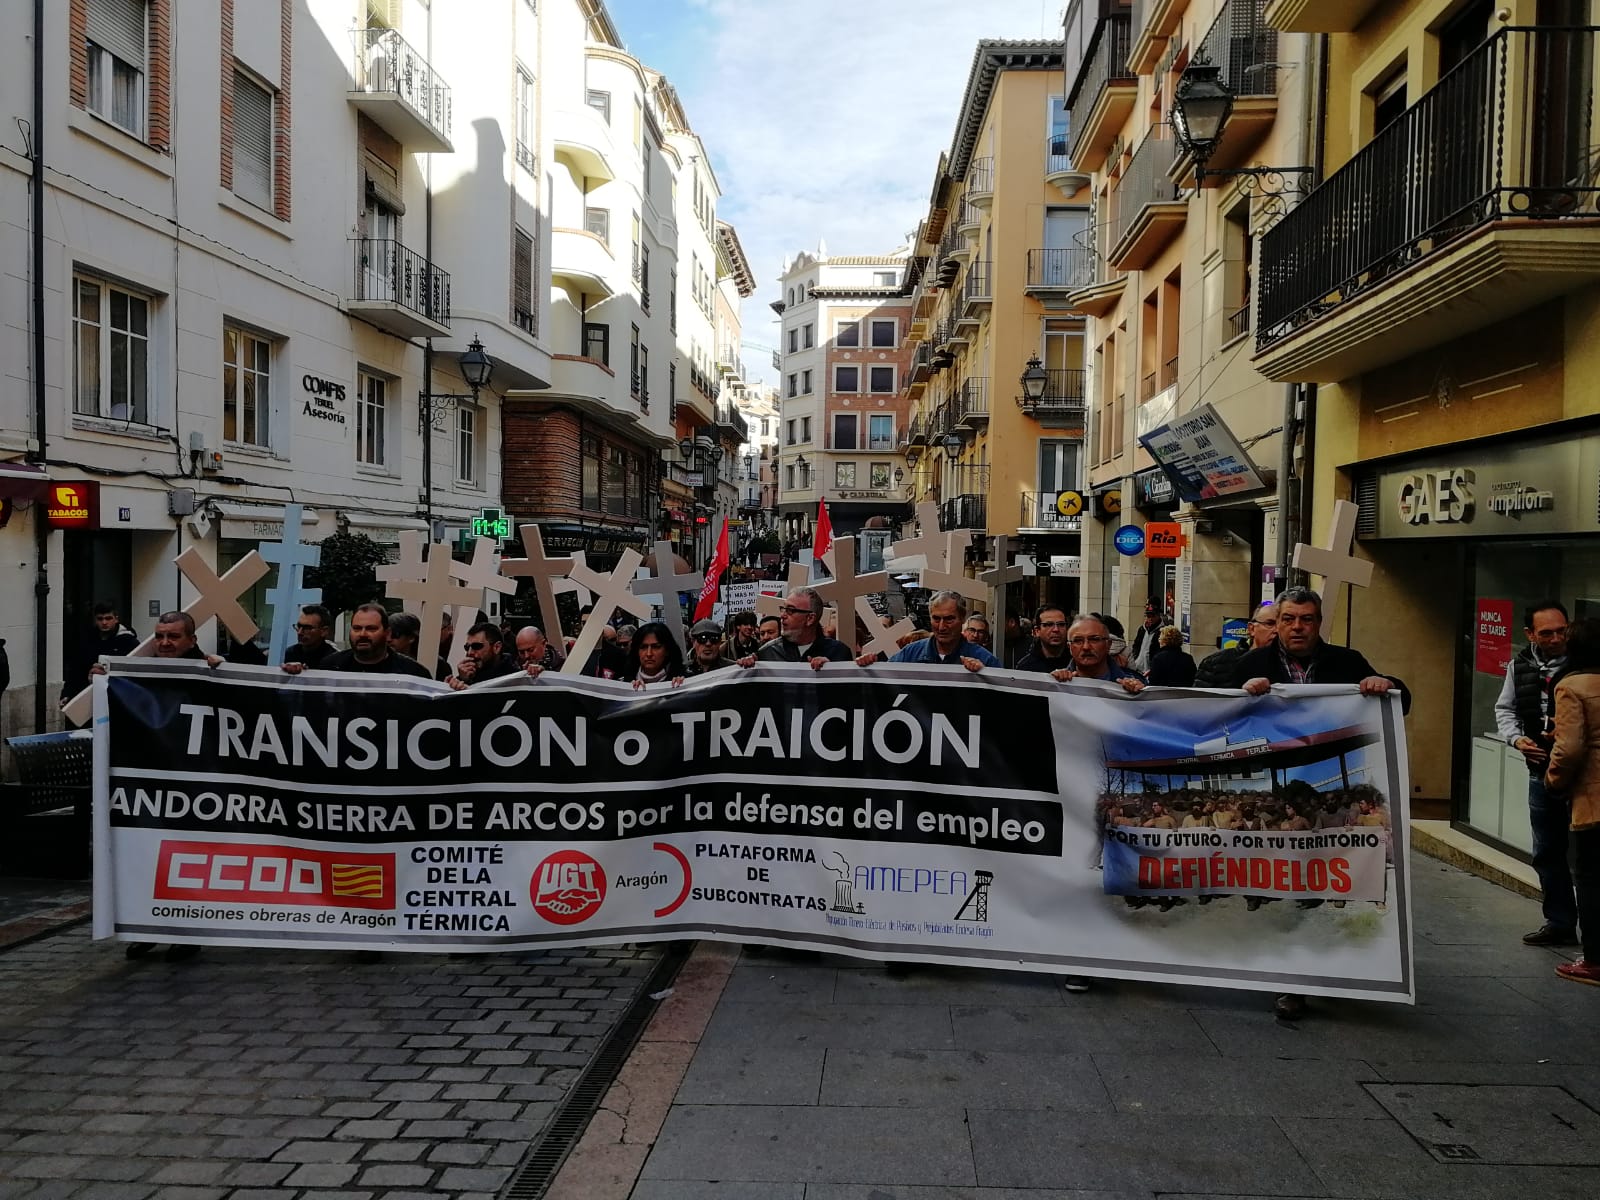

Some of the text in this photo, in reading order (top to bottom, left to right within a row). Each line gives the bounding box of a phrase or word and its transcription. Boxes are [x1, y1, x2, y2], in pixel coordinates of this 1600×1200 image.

[303, 374, 346, 401] COMFIS
[302, 400, 345, 424] Asesoría
[1398, 468, 1475, 524] GAES
[1487, 487, 1547, 517] amplifon
[48, 509, 88, 517] TABACOS
[120, 508, 131, 519] 10
[253, 523, 284, 537] FARMAC
[1150, 529, 1177, 543] Ria
[1480, 611, 1502, 623] NUNCA
[1480, 624, 1507, 637] ES TARDE
[180, 694, 981, 771] TRANSICIÓN o TRAICIÓN
[1245, 744, 1273, 756] TERUEL
[110, 787, 1046, 845] ANDORRA SIERRA DE ARCOS por la defensa del empleo
[1106, 828, 1139, 846] POR
[1142, 834, 1161, 847] TU
[1232, 835, 1264, 848] POR
[1267, 837, 1285, 849] TU
[1289, 833, 1379, 850] TERRITORIO
[411, 844, 504, 865] COMITÉ
[695, 843, 817, 864] PLATAFORMA
[167, 852, 323, 894] CCOO
[427, 867, 492, 884] DE LA
[540, 862, 598, 890] UGT
[615, 871, 668, 890] Aragón
[747, 867, 770, 883] DE
[854, 865, 967, 896] AMEPEA
[1138, 852, 1352, 893] DEFIÉNDELOS
[405, 890, 517, 907] CENTRAL
[692, 888, 827, 911] SUBCONTRATAS
[151, 905, 396, 928] comisiones obreras de Aragón
[403, 910, 510, 932] TÉRMICA
